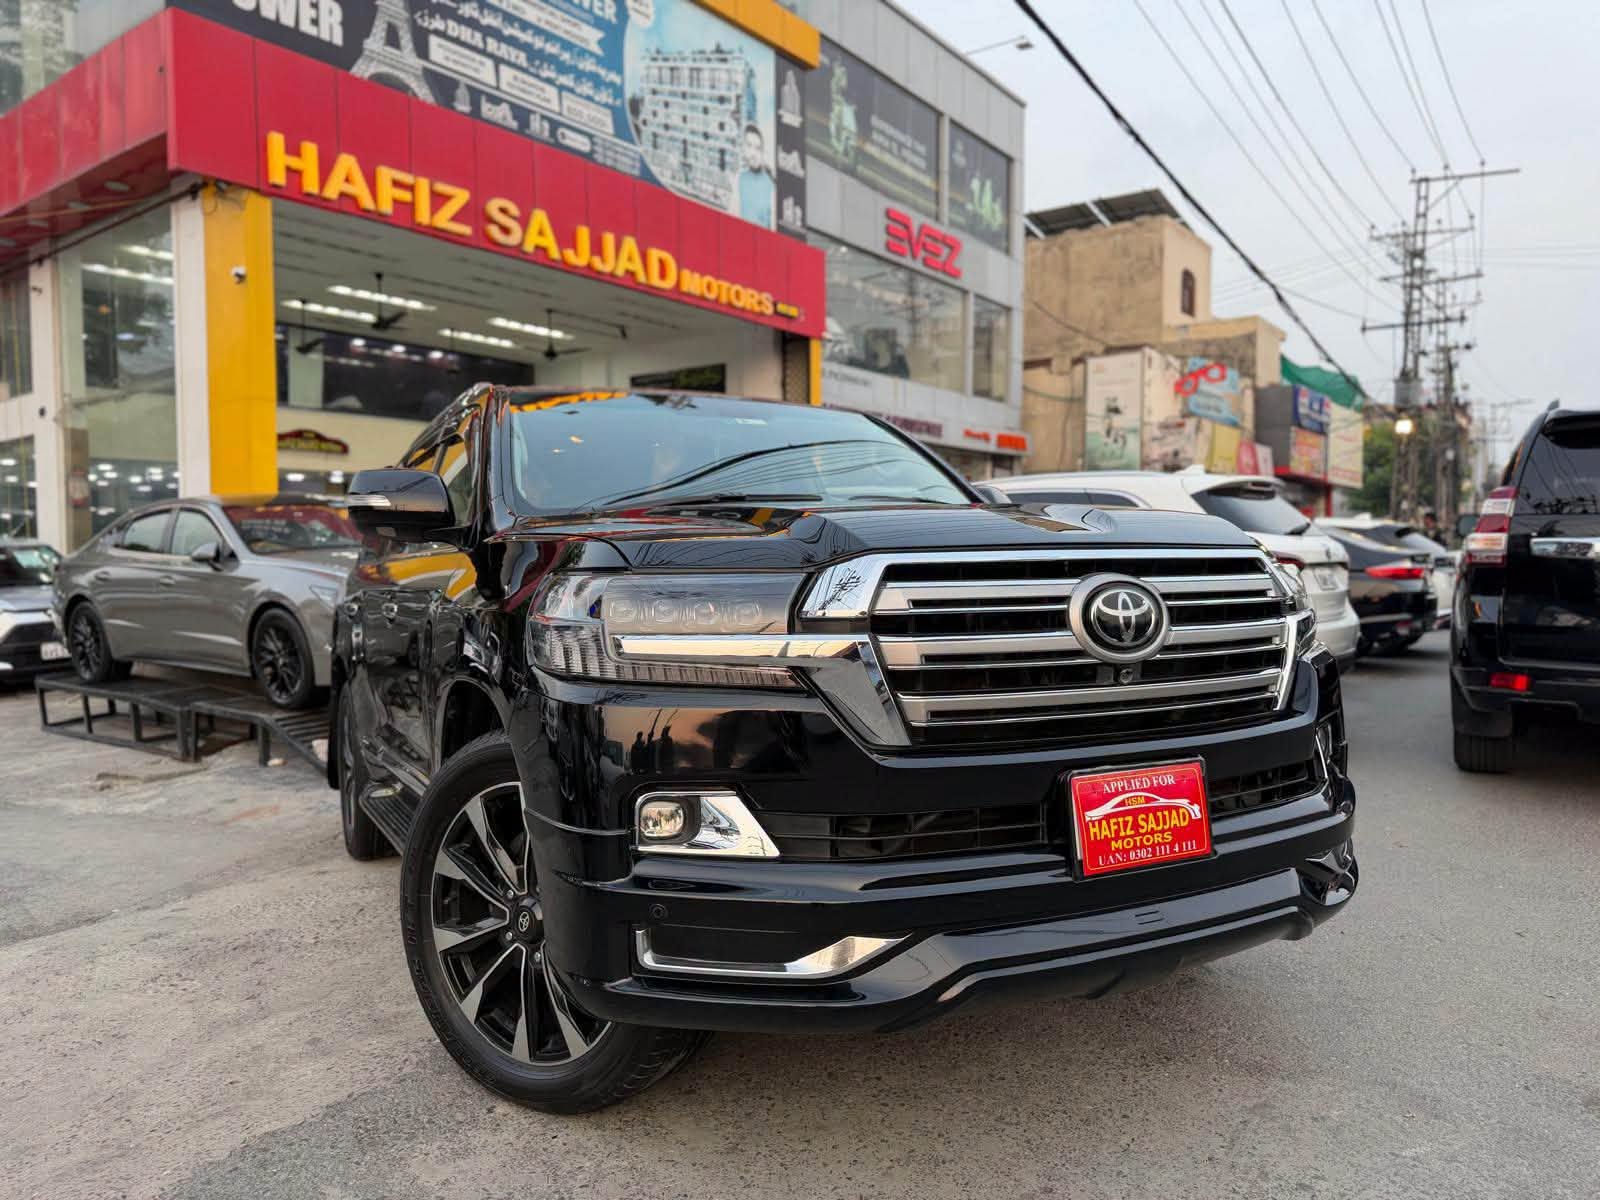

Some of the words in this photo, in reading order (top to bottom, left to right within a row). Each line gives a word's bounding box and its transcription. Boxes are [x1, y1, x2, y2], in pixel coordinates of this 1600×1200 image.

[232, 0, 344, 47] WER
[267, 131, 473, 236] HAFIZ
[485, 198, 678, 290] SAJJAD
[680, 269, 774, 315] MOTORS
[1103, 777, 1150, 794] APPLIED
[1154, 775, 1175, 787] FOR
[1125, 796, 1145, 806] HSM
[1088, 816, 1135, 841] HAFIZ
[1138, 808, 1190, 833] SAJJAD
[1098, 852, 1127, 866] UAN:
[1129, 847, 1153, 861] 0302
[1155, 845, 1171, 856] 111
[1173, 843, 1179, 853] 4
[1182, 840, 1197, 851] 111
[1111, 832, 1173, 851] MOTORS
